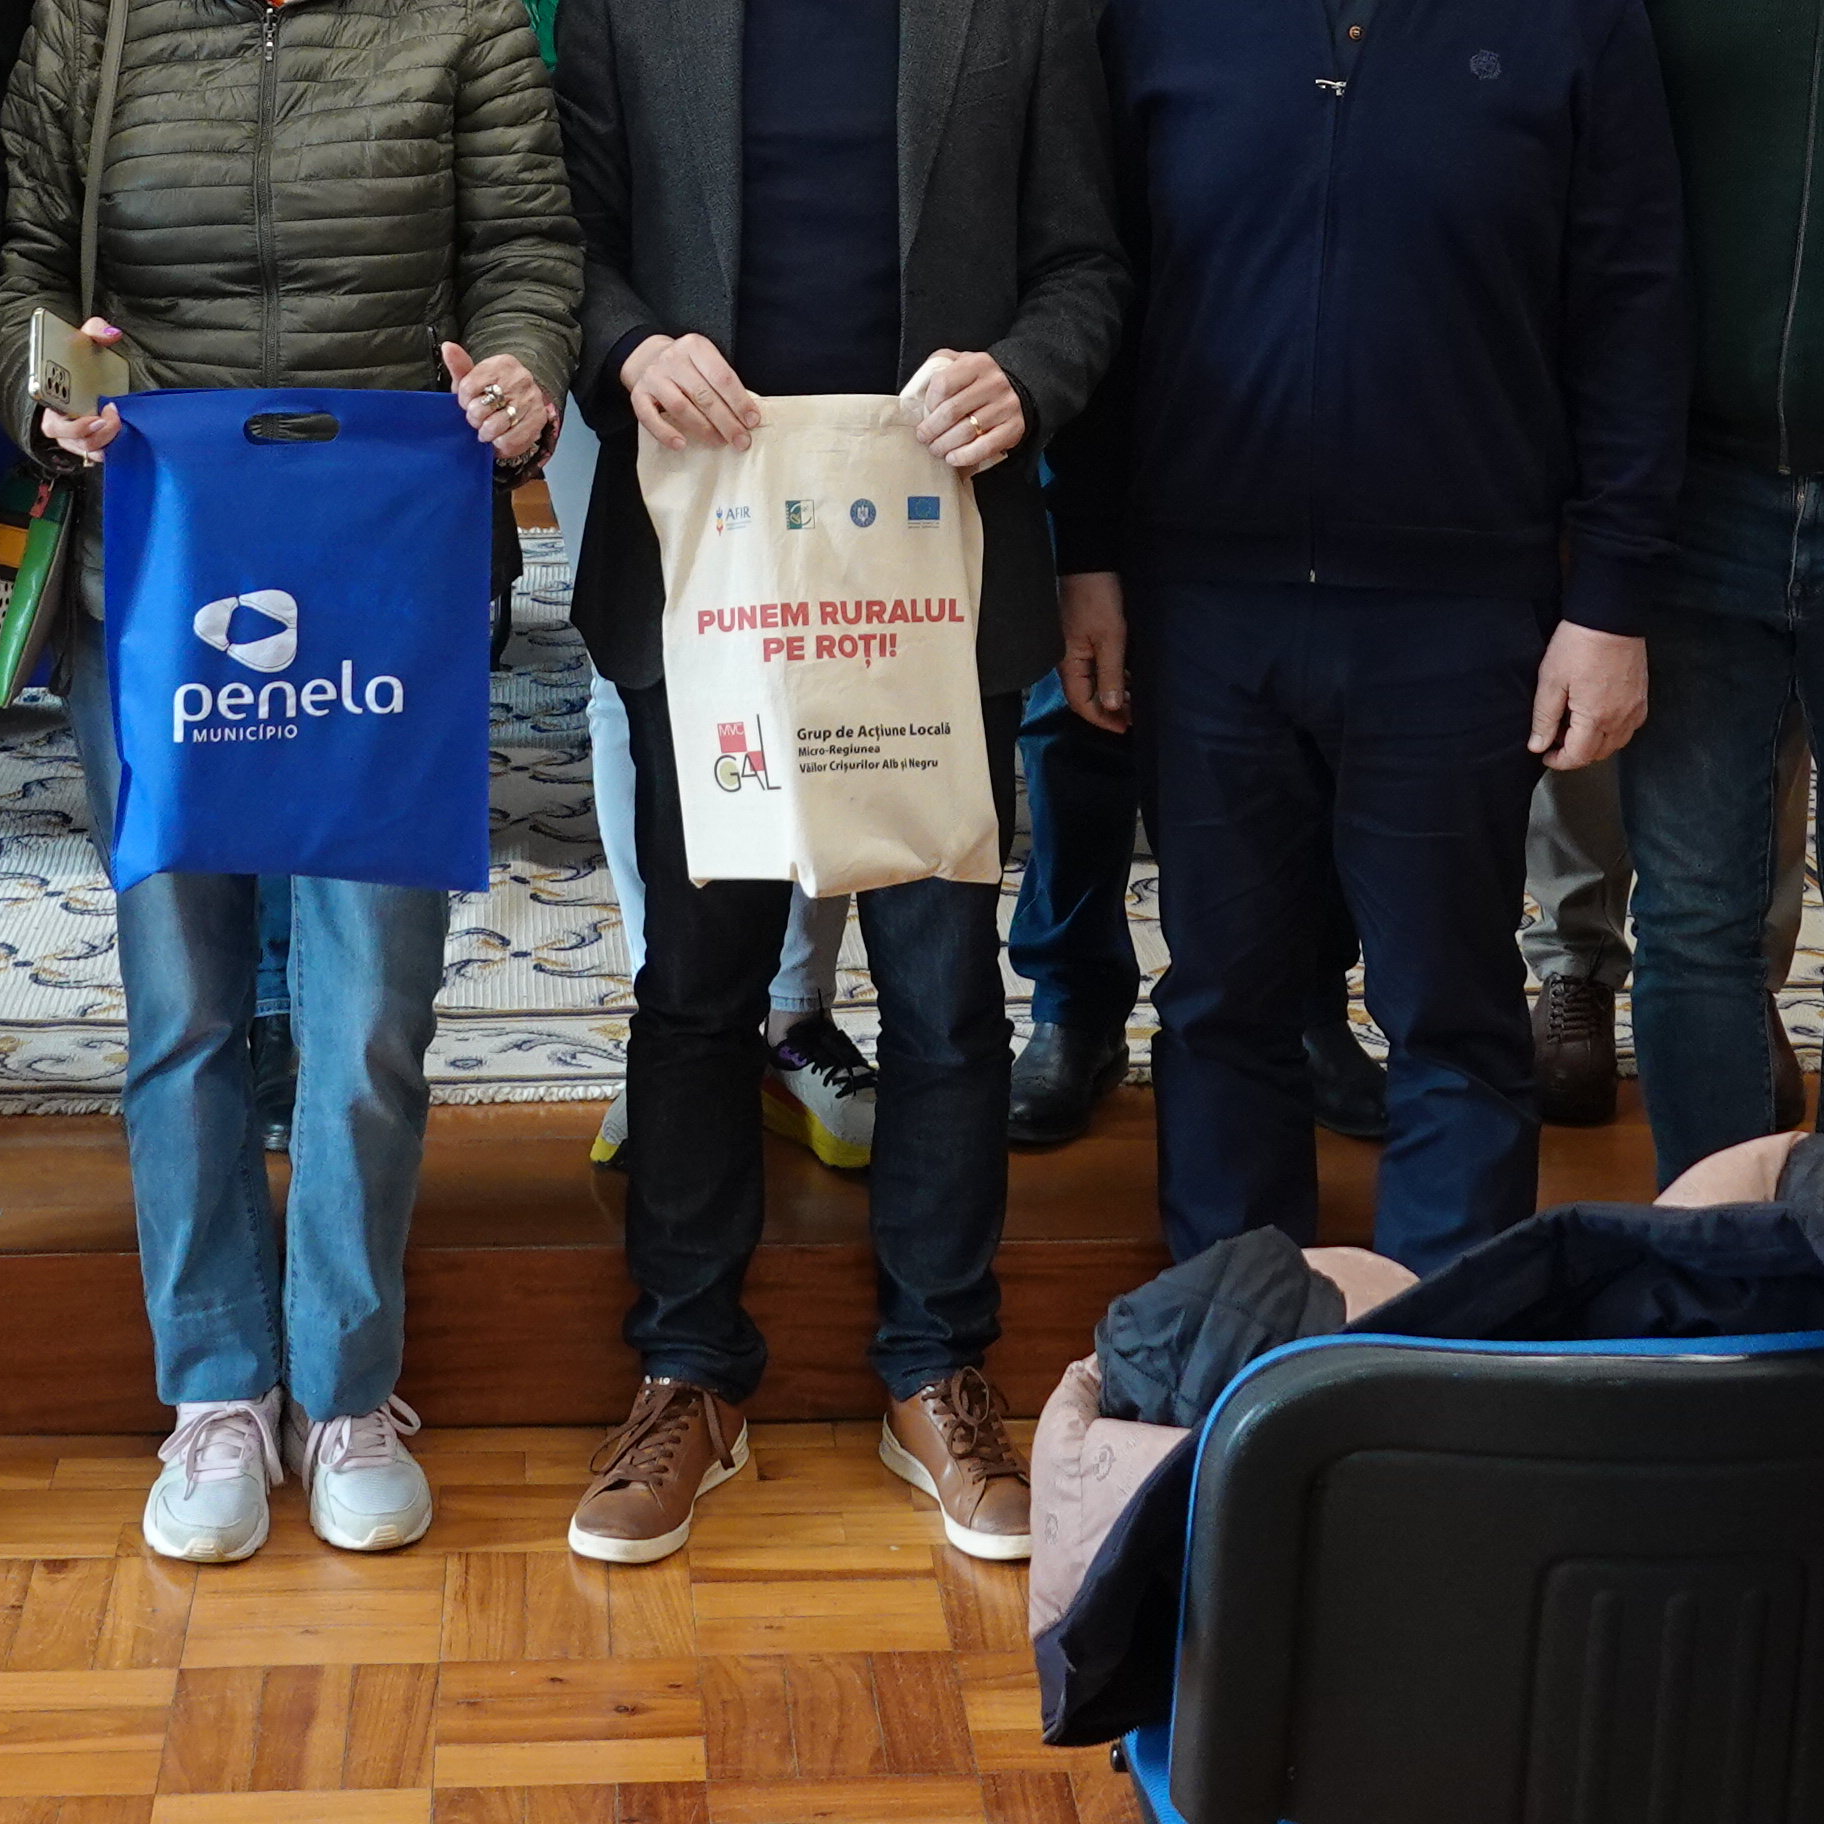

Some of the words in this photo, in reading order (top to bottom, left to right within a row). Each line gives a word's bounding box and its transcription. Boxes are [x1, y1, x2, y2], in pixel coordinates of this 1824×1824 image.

[725, 505, 751, 521] AFIR
[697, 601, 810, 635] PUNEM
[819, 597, 965, 626] RURALUL
[763, 635, 805, 663] PE
[815, 632, 898, 669] ROȚI!
[173, 659, 405, 743] penela
[192, 723, 298, 743] MUNICÍPIO
[719, 723, 744, 736] MVC
[797, 727, 832, 742] Grup
[835, 725, 854, 738] de
[909, 721, 951, 736] Locală
[714, 713, 782, 793] GAL
[798, 743, 880, 757] Micro-Regiunea
[799, 762, 827, 774] Văilor
[882, 758, 899, 770] Alb
[909, 757, 939, 771] Negru
